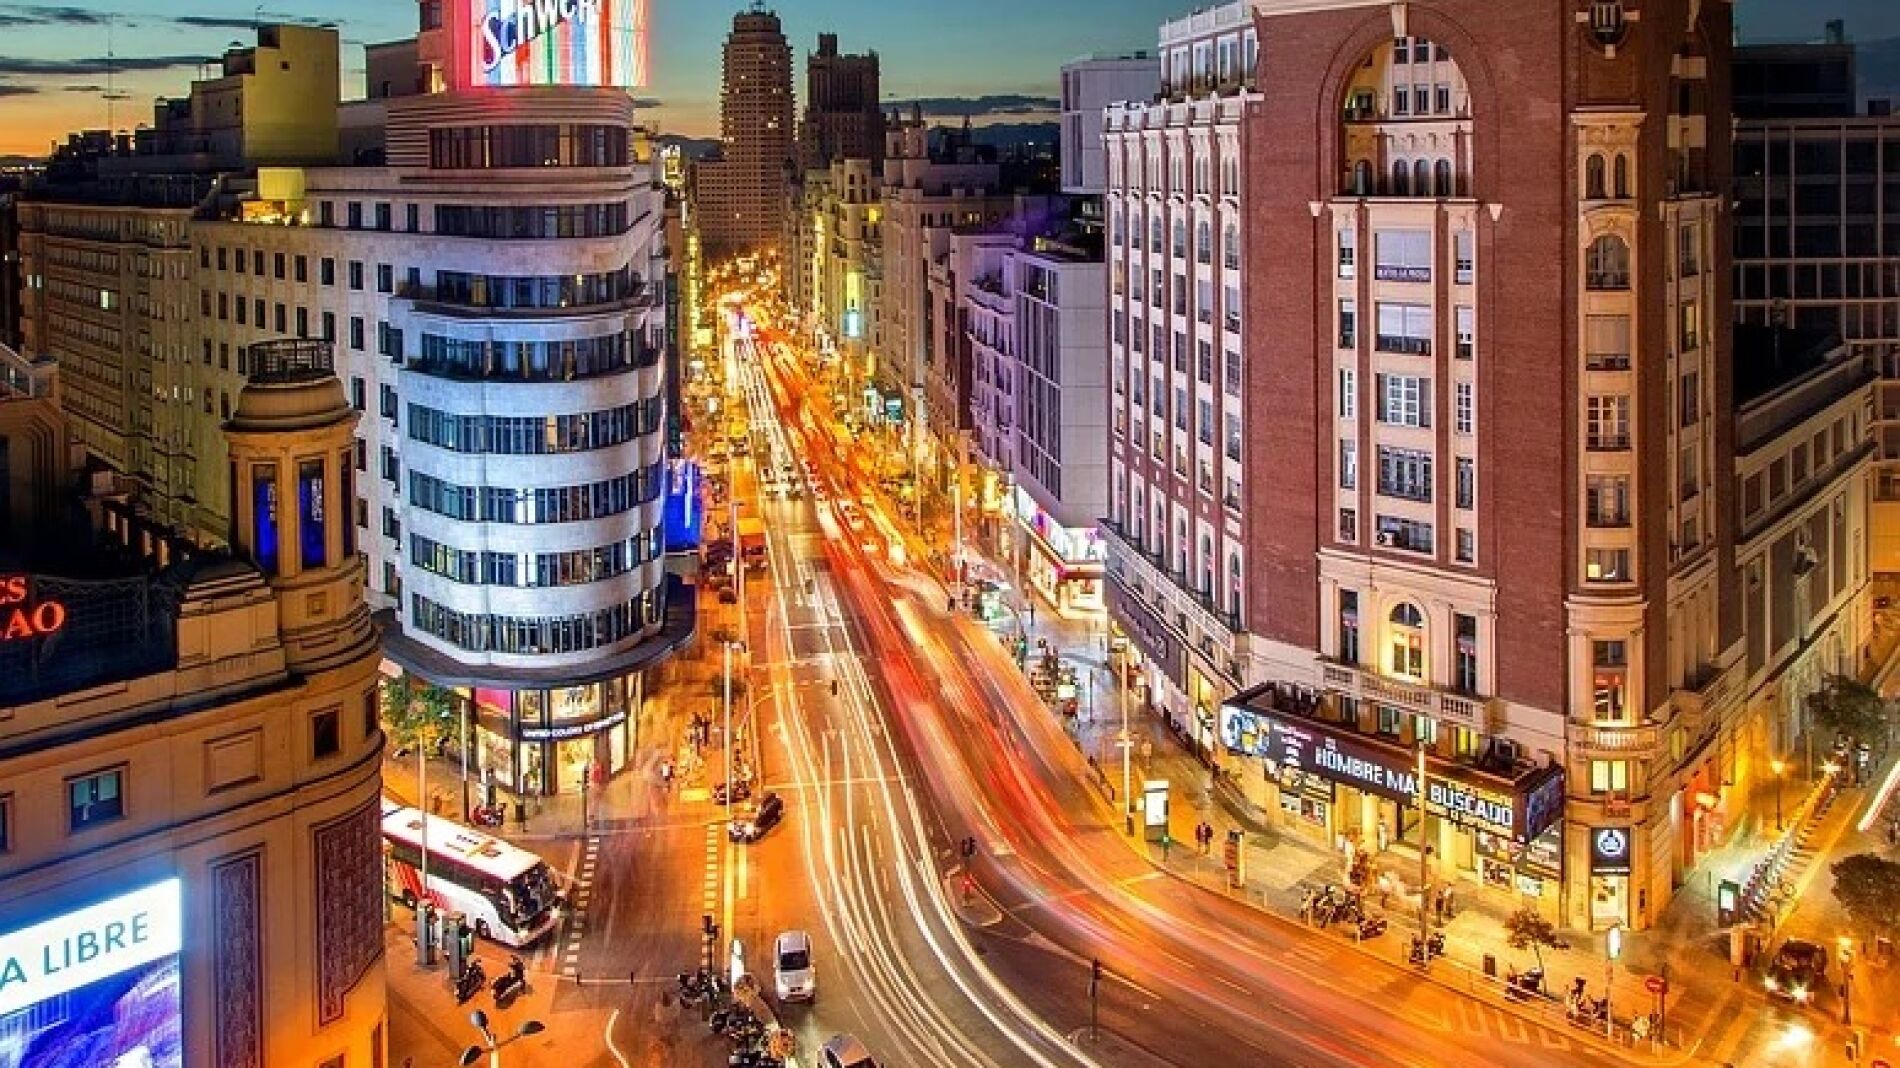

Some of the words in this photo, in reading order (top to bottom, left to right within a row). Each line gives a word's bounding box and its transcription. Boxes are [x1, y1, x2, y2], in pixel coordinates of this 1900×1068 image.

[0, 601, 65, 639] AO
[1315, 746, 1383, 784] HOMBRE
[1430, 783, 1513, 826] BUSCADO
[43, 911, 149, 976] LIBRE
